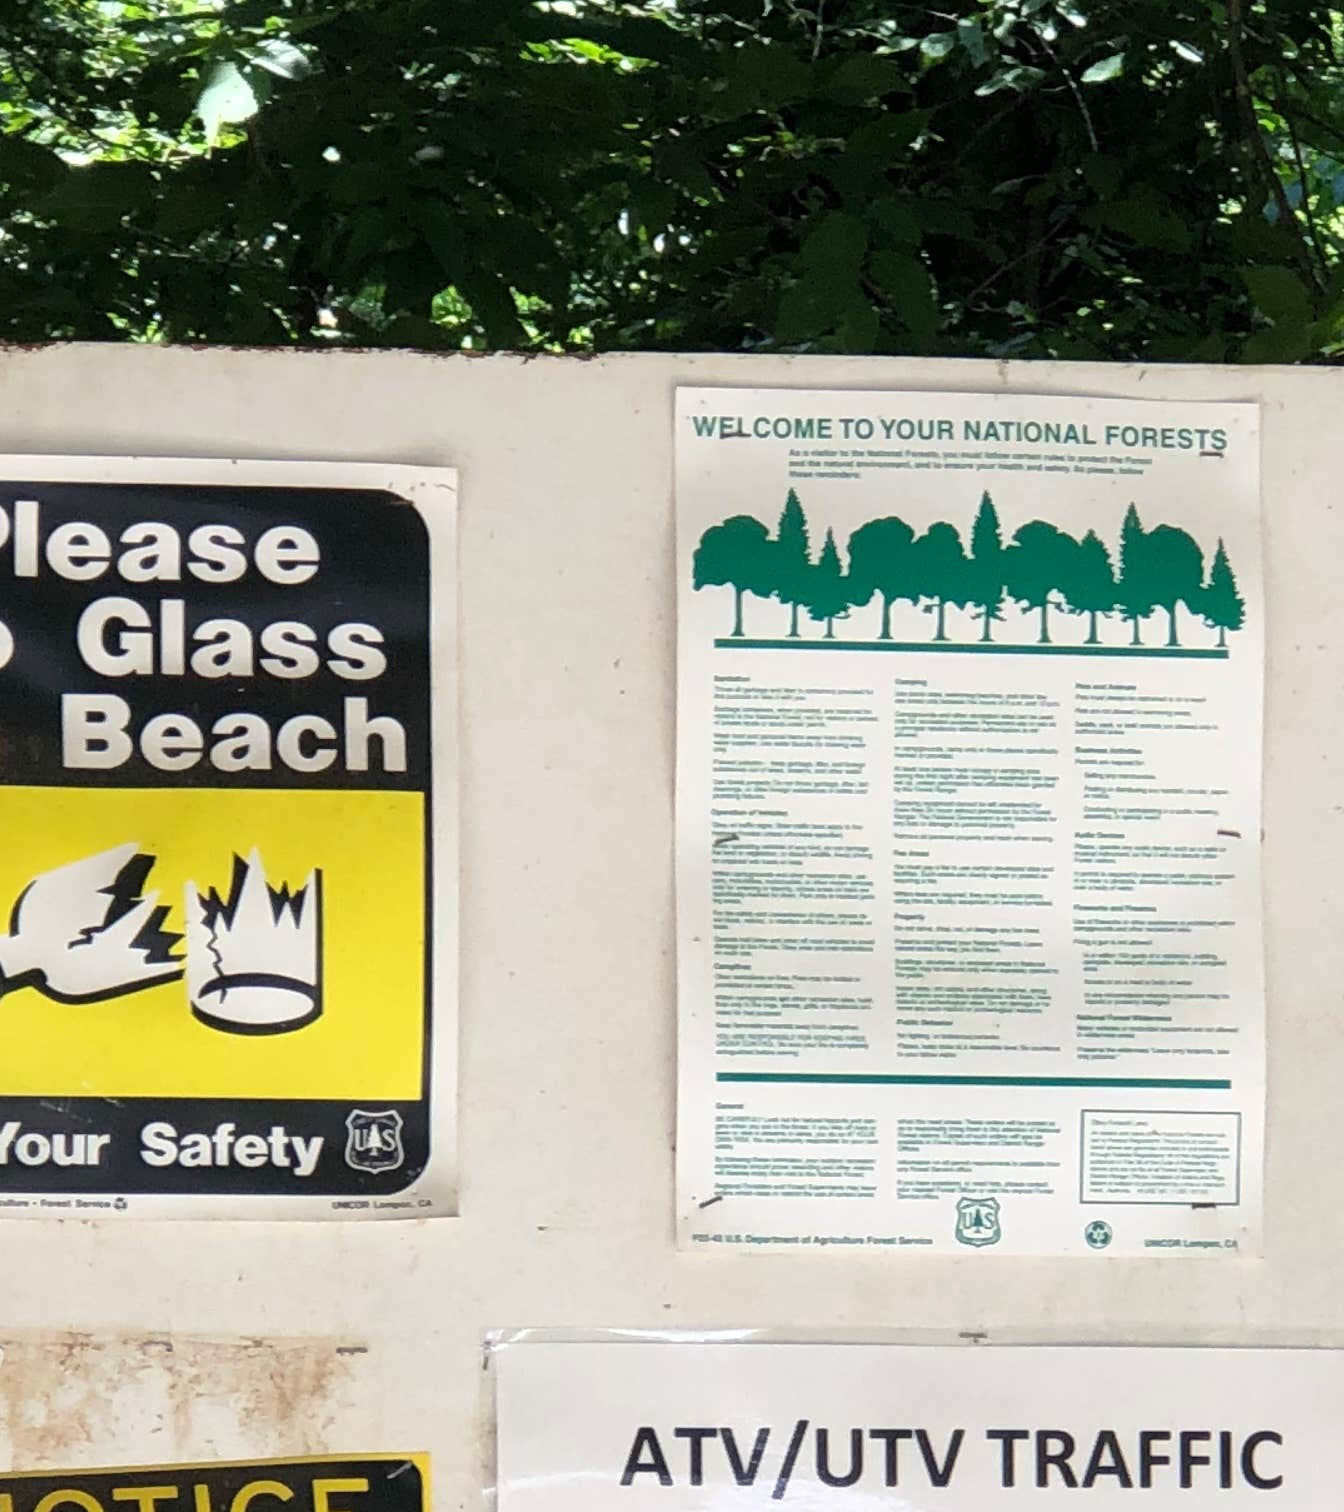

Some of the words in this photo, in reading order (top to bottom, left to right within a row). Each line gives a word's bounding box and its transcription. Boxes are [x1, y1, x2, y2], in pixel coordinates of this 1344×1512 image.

[693, 416, 832, 440] WELCOME
[839, 418, 875, 440] TO
[880, 418, 955, 442] YOUR
[963, 420, 1097, 445] NATIONAL
[1105, 425, 1228, 451] FORESTS
[77, 596, 387, 680] Glass
[61, 693, 407, 773] Beach
[140, 1121, 325, 1176] Safety
[39, 1199, 72, 1208] Forest
[75, 1199, 112, 1208] Service
[813, 1235, 865, 1246] Agriculture
[866, 1236, 897, 1245] Forest
[899, 1236, 934, 1245] Service
[620, 1419, 966, 1500] ATV/UTV
[986, 1429, 1283, 1490] TRAFFIC
